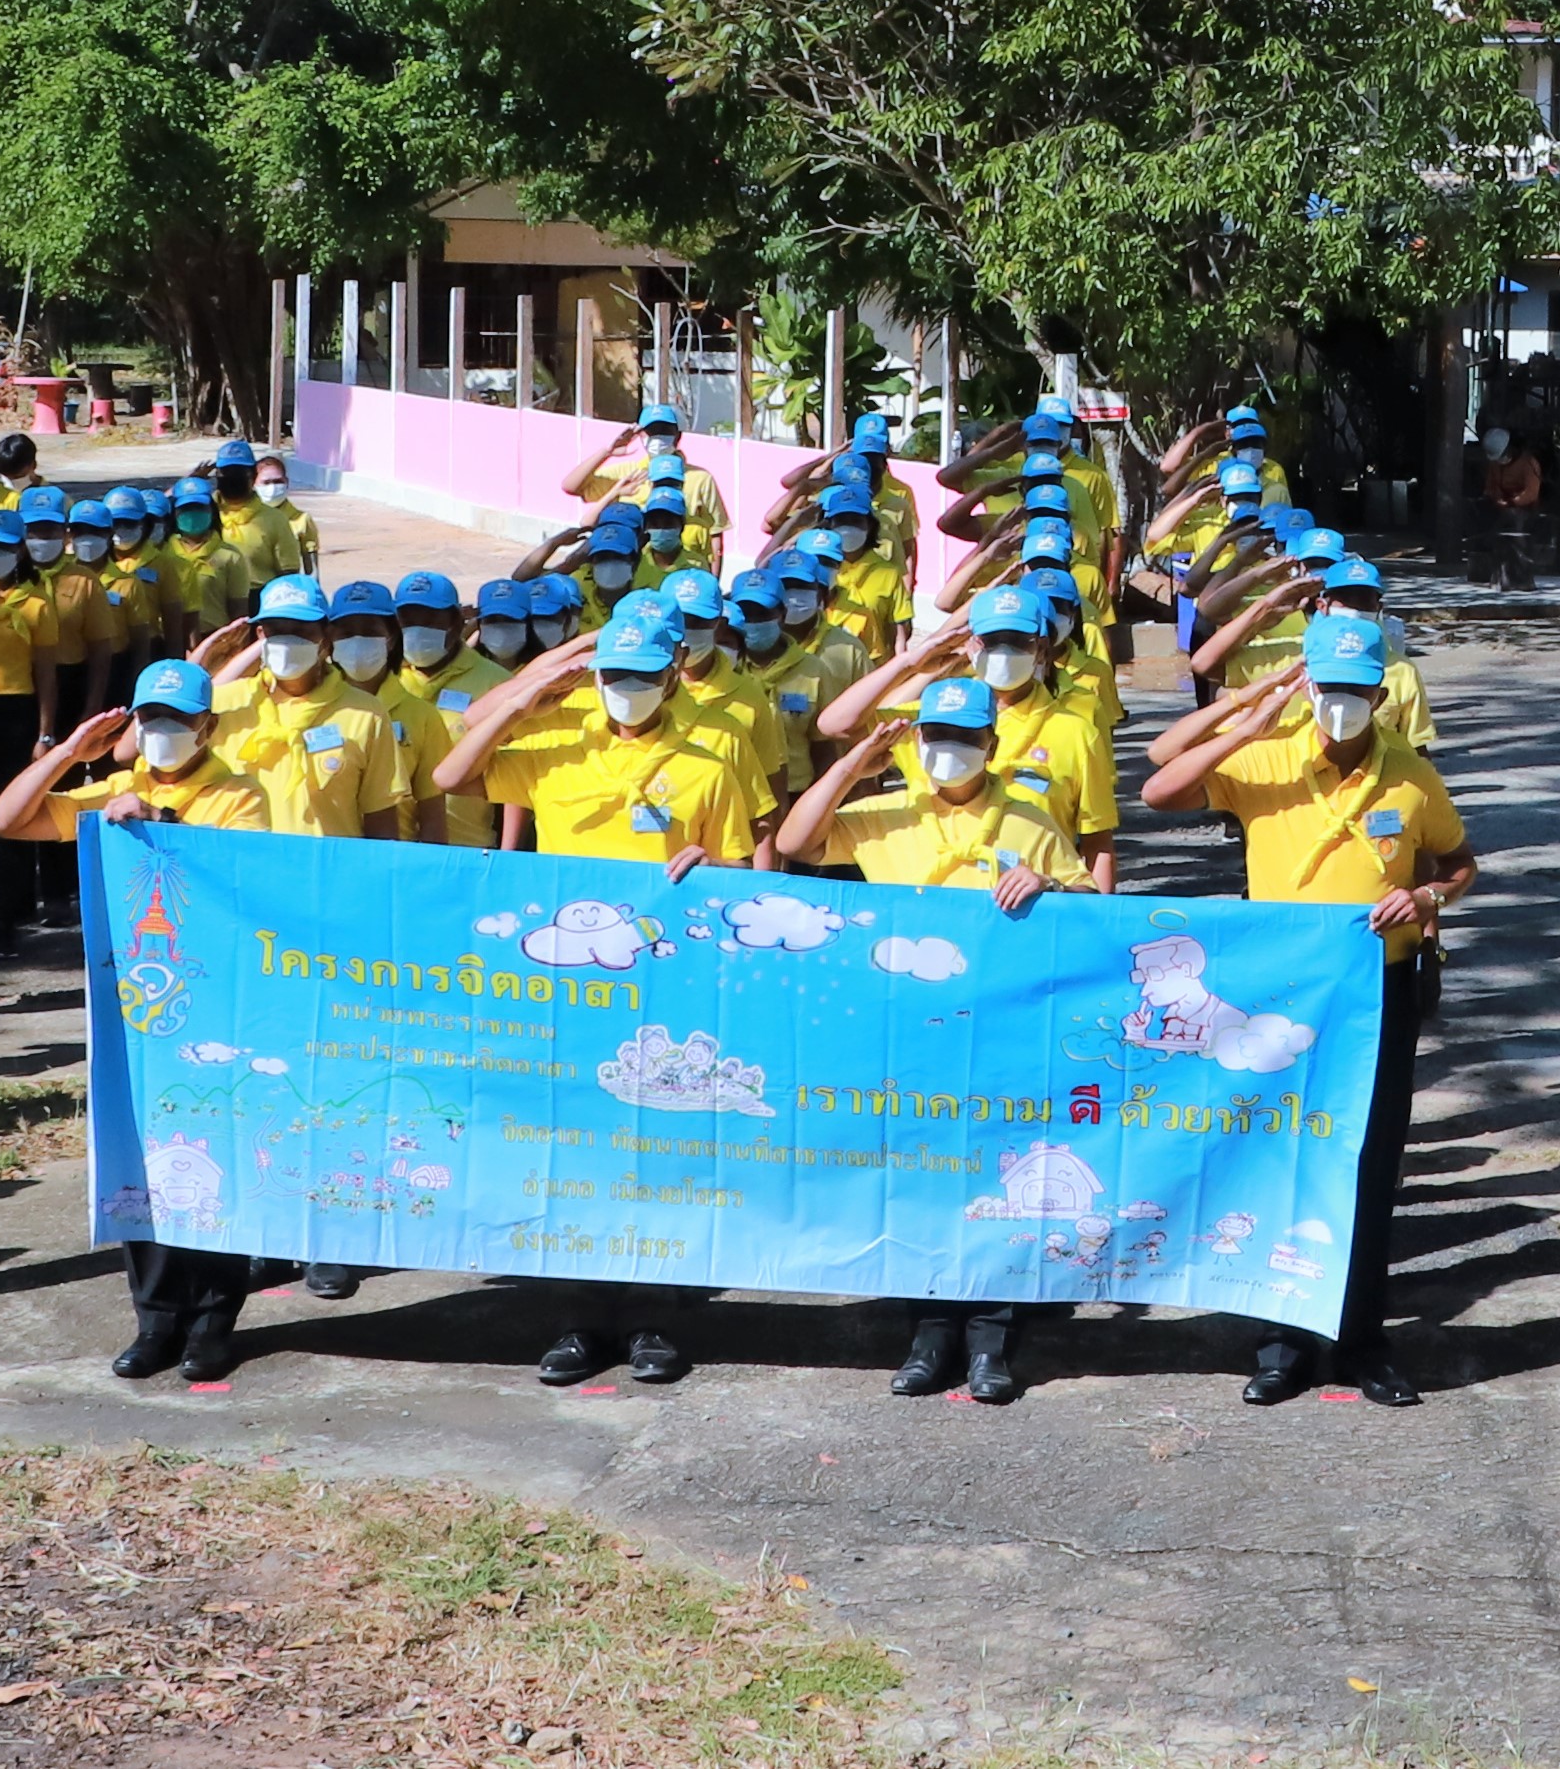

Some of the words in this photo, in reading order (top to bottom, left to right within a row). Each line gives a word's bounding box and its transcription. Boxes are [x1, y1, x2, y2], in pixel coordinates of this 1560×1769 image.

[255, 929, 640, 1011] โครงการจิตอาสา
[797, 1078, 1052, 1126] เราทำความ
[1069, 1084, 1101, 1125] ดี
[1118, 1083, 1334, 1139] ด้วยหัวใจ
[500, 1114, 594, 1148] จิตอาสา
[522, 1169, 594, 1200] อำเภอ
[509, 1226, 594, 1256] จังหวัด
[607, 1229, 687, 1260] ยโสธร
